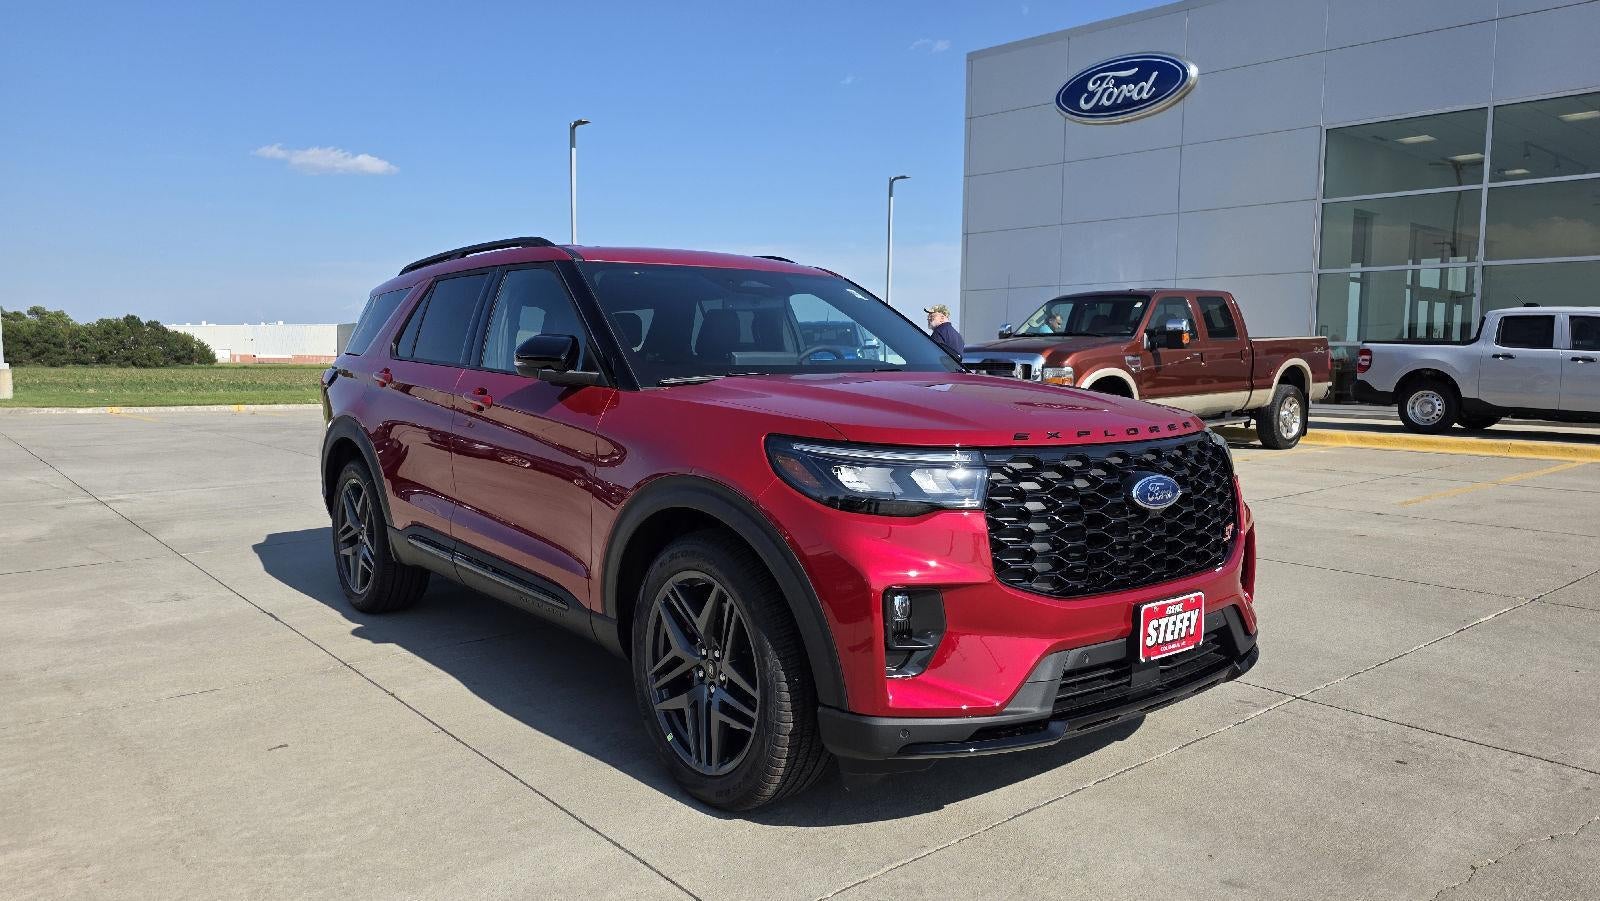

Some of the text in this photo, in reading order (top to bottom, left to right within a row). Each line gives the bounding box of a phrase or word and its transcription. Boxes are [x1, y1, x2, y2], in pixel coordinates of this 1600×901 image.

[1079, 67, 1159, 110] Ford
[1013, 421, 1192, 441] EXPLORER
[1147, 482, 1173, 502] Ford
[1145, 608, 1200, 647] STEFFY
